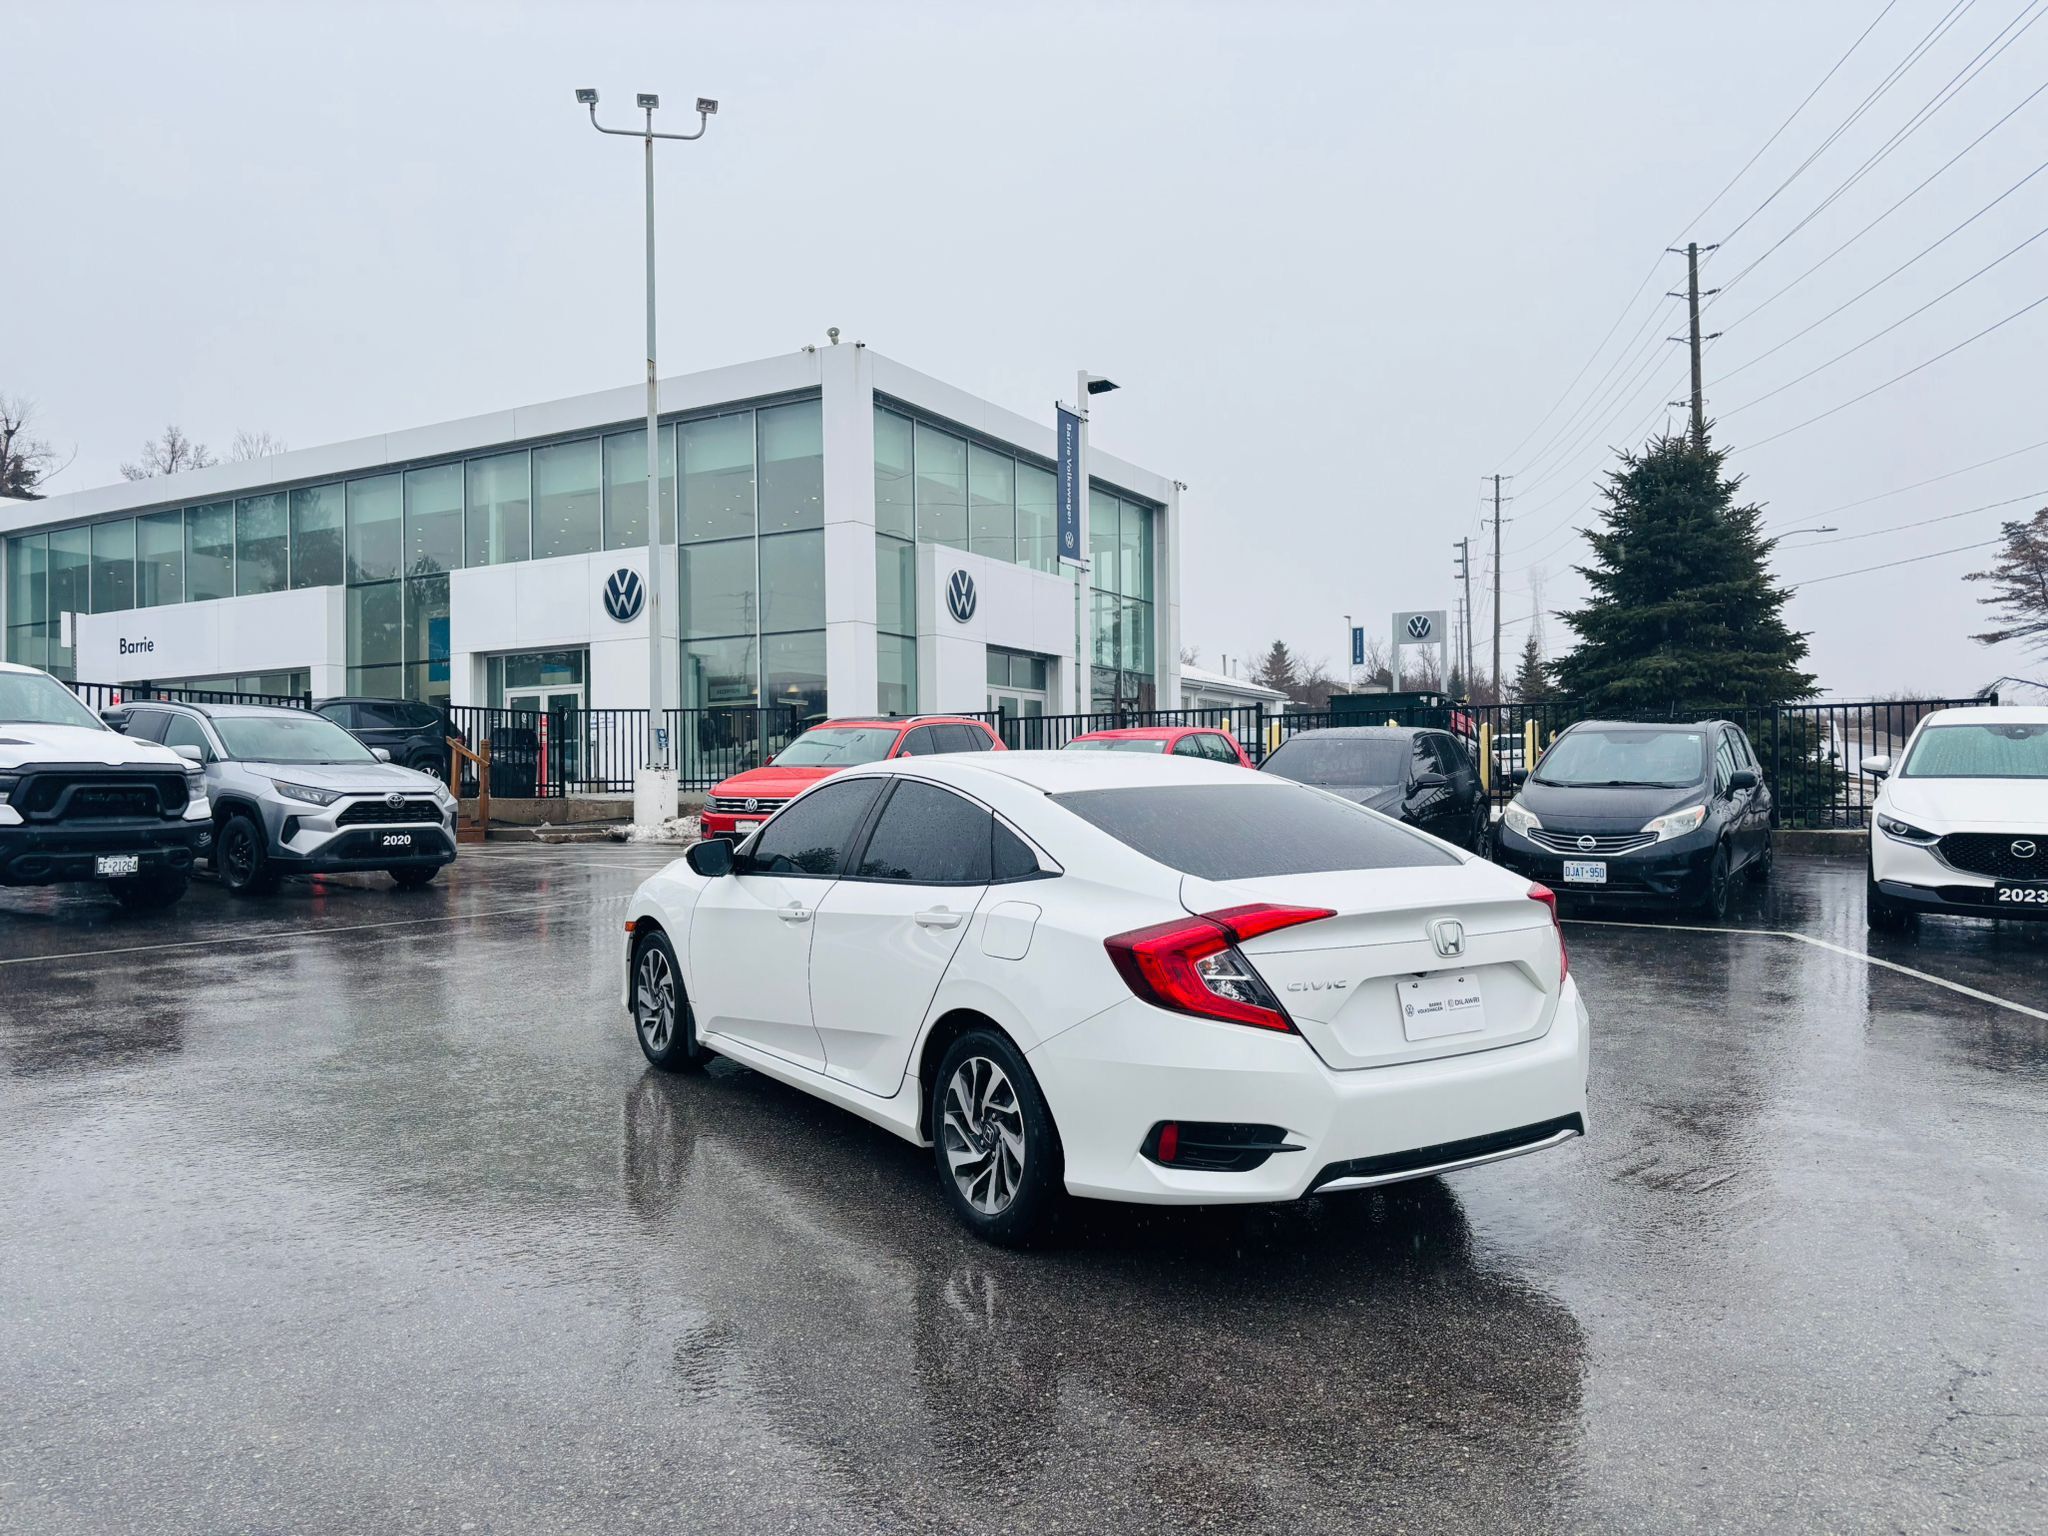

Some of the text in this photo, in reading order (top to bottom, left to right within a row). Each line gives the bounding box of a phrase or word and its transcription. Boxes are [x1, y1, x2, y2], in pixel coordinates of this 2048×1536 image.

[119, 636, 154, 654] Barrie
[383, 835, 411, 845] 2020
[1999, 888, 2048, 903] 2023
[1286, 980, 1347, 992] CIVIC
